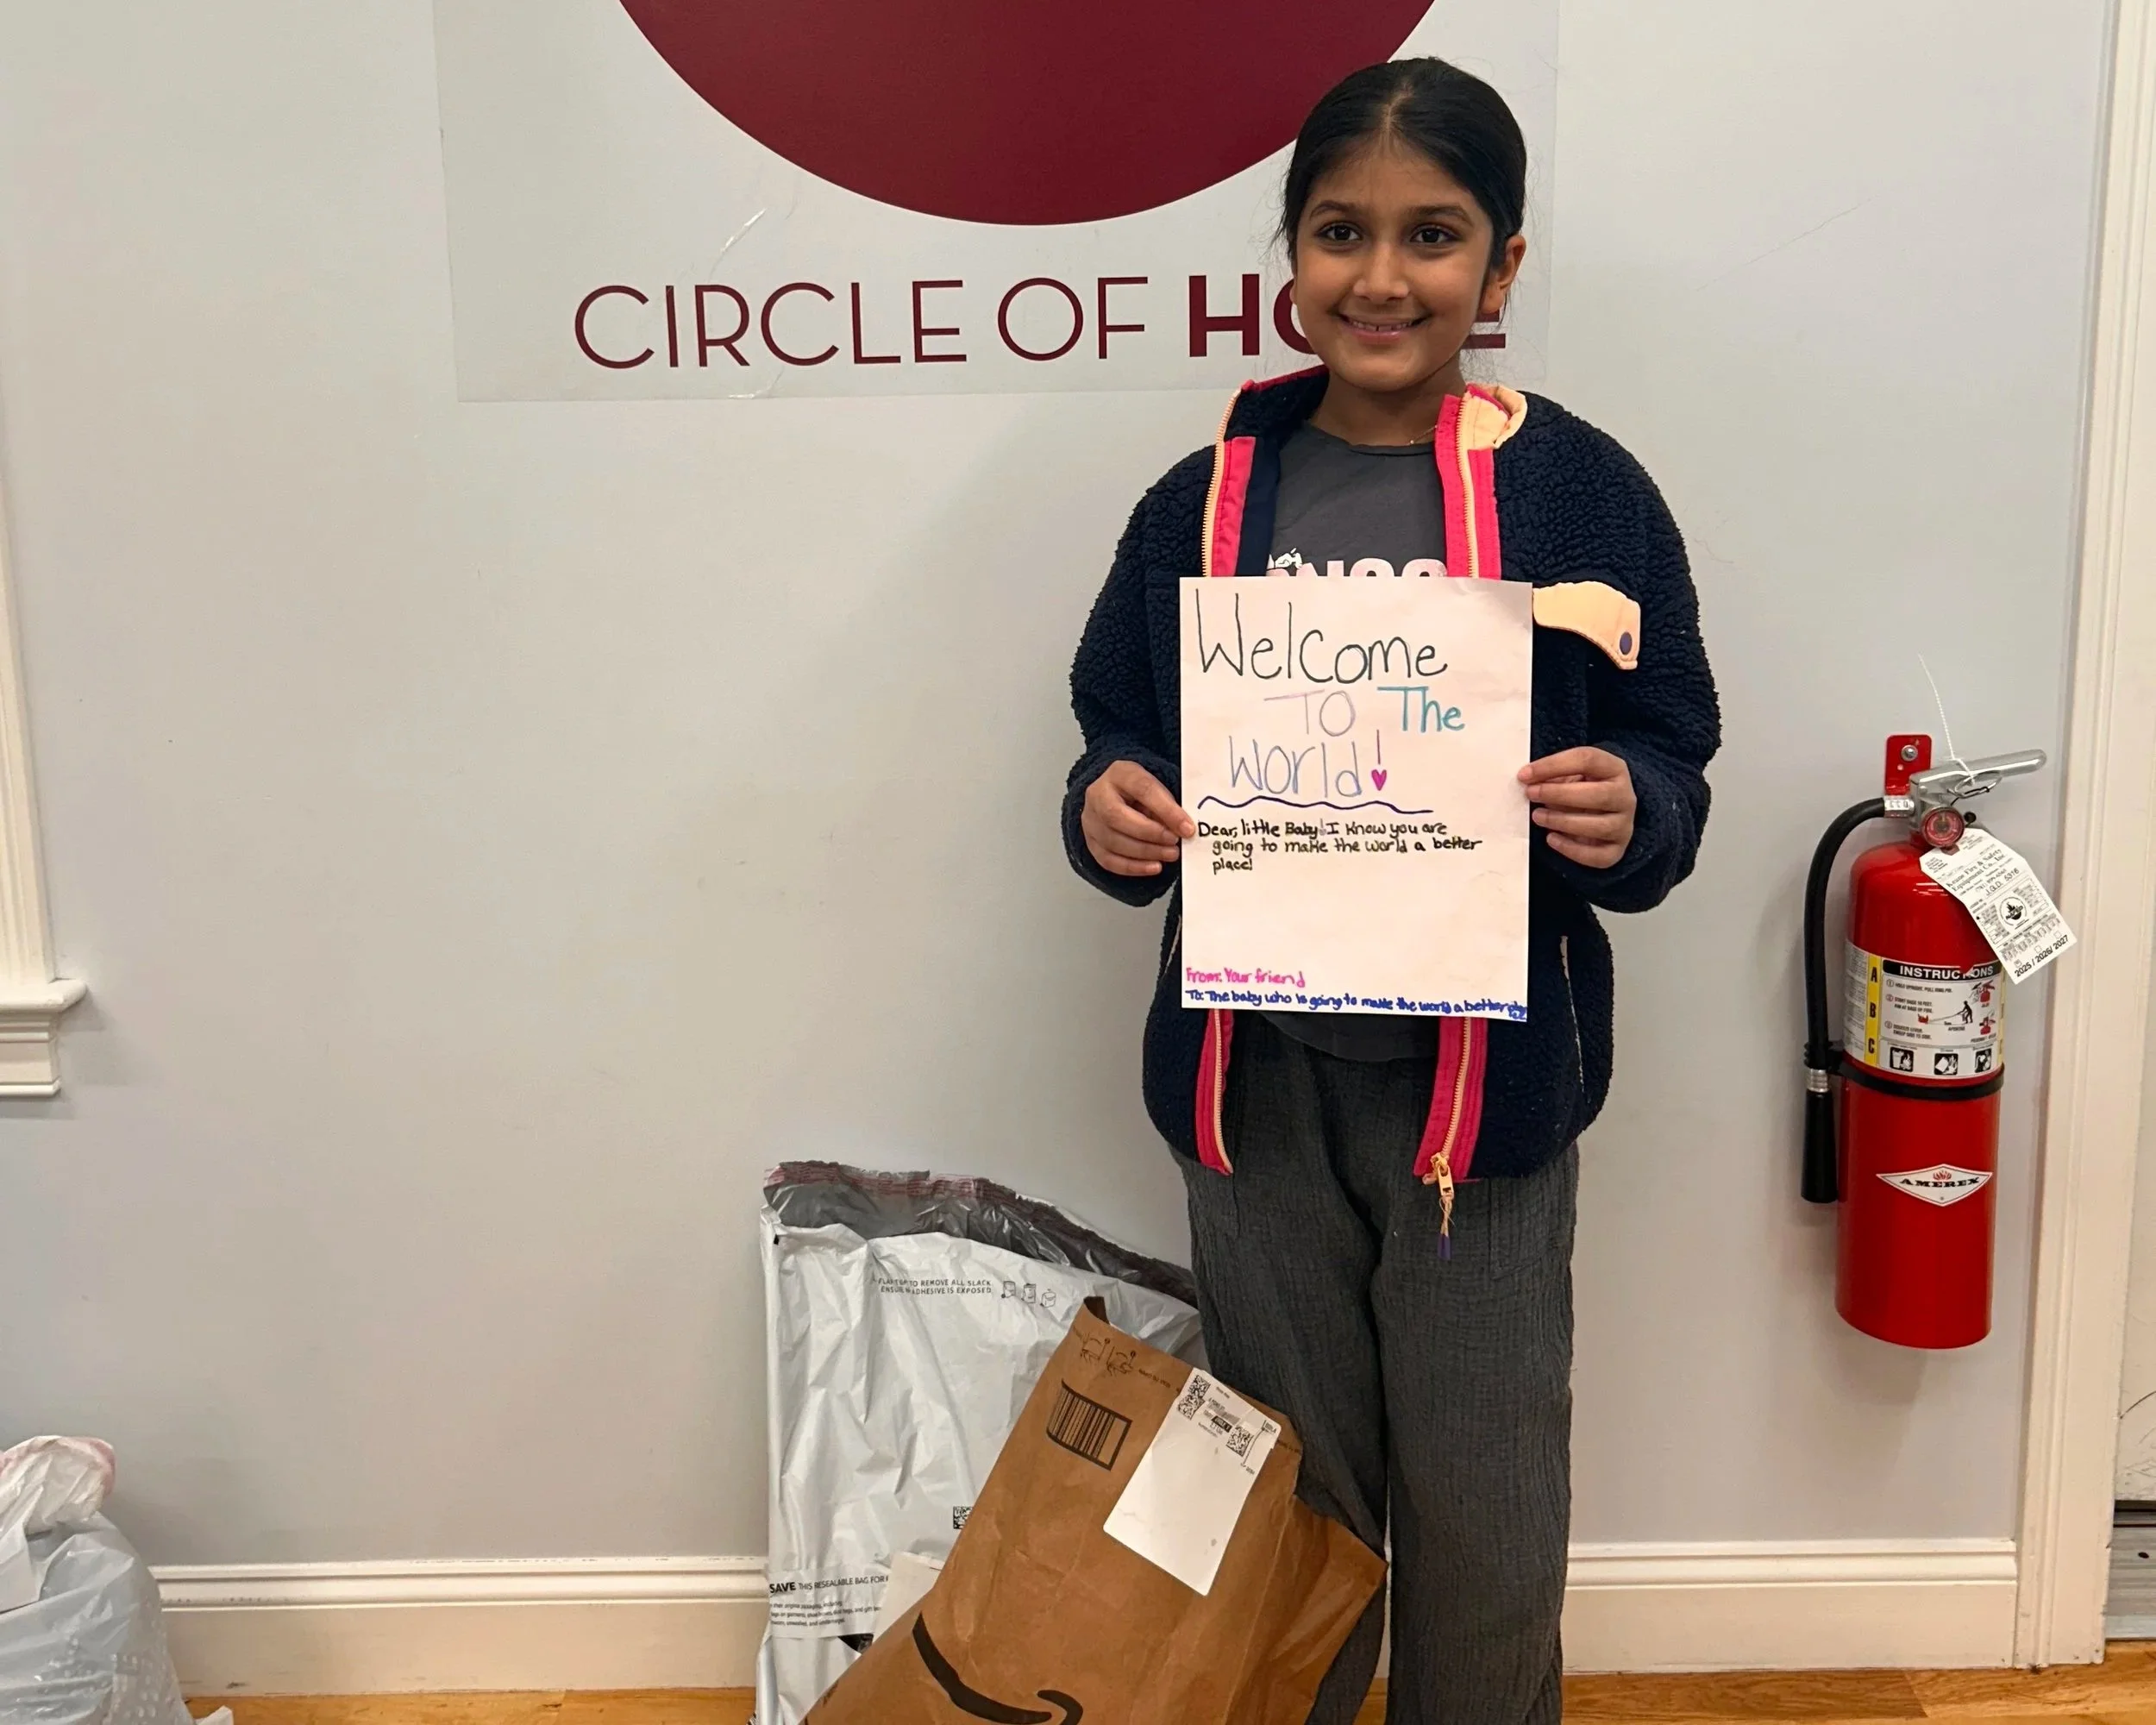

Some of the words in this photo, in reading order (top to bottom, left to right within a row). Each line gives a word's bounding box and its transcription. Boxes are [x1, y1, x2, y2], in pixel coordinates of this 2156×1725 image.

[574, 279, 967, 369] CIRCLE
[997, 276, 1148, 360] OF
[1376, 685, 1465, 733] The
[1198, 821, 1238, 838] Dear,
[1241, 819, 1281, 837] little
[1326, 822, 1339, 835] I
[1389, 823, 1418, 839] you
[1422, 822, 1448, 835] are
[1212, 839, 1253, 858] going
[1261, 837, 1278, 852] to
[1335, 837, 1361, 853] the
[1365, 837, 1407, 854] world
[1414, 841, 1426, 852] a
[1432, 835, 1483, 850] better
[1213, 857, 1253, 875] place!
[2014, 962, 2033, 977] 2025
[2053, 934, 2069, 950] 2027
[1224, 967, 1252, 983] Your
[1255, 968, 1306, 988] friend
[1871, 967, 1877, 982] A
[1900, 965, 1993, 980] INSTRUCONS
[1205, 990, 1231, 1002] The
[1232, 990, 1263, 1007] baby
[1264, 990, 1292, 1004] who
[1308, 994, 1343, 1011] going
[1344, 993, 1357, 1006] to
[1396, 997, 1417, 1012] the
[1453, 1003, 1464, 1013] a
[1463, 998, 1508, 1013] better
[1870, 1002, 1876, 1018] B
[1868, 1038, 1875, 1054] C
[1899, 1176, 1979, 1188] AMEREX
[769, 1582, 796, 1593] SAVE
[814, 1578, 853, 1589] RESEALABLE
[855, 1576, 868, 1584] BAG
